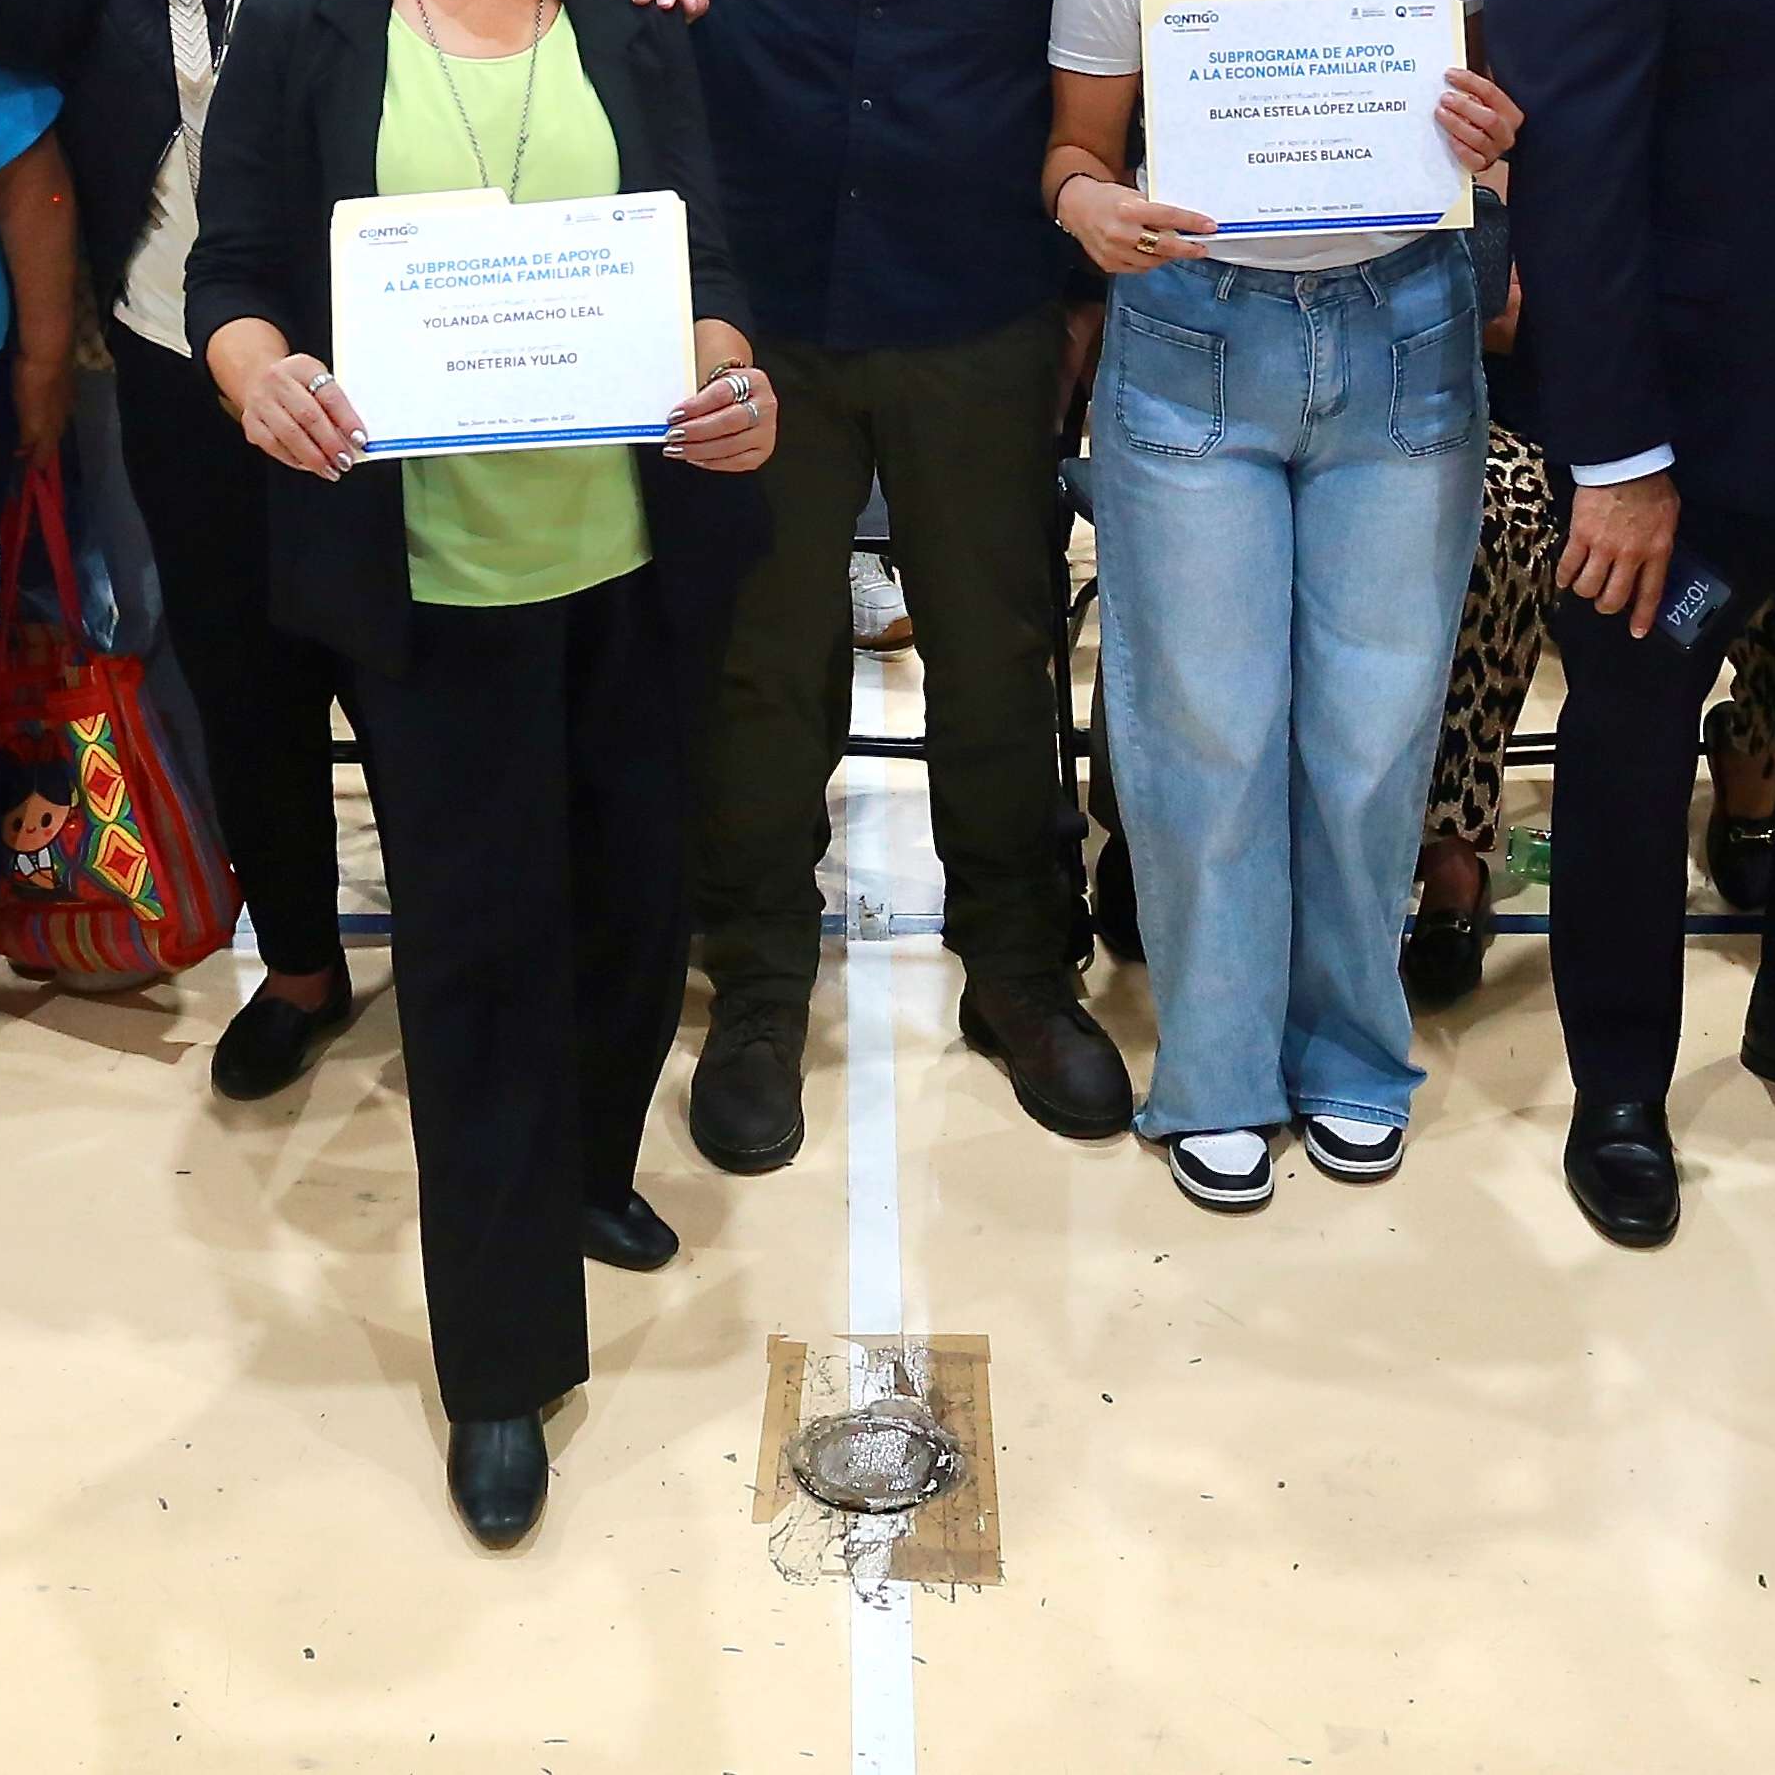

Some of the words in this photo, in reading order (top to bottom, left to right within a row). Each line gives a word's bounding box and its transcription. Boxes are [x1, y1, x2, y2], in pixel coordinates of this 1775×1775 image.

[1164, 10, 1219, 27] CONTIGO
[1208, 48, 1318, 64] SUBPROGRAMA
[1323, 47, 1342, 59] DE
[1345, 44, 1395, 58] APOYO
[1189, 69, 1200, 82] A
[1203, 68, 1222, 81] LA
[1225, 64, 1305, 79] ECONOMÍA
[1309, 61, 1376, 76] FAMILIAR
[1380, 59, 1416, 74] (PAE)
[1209, 106, 1260, 120] BLANCA
[1264, 104, 1311, 117] ESTELA
[1313, 101, 1354, 115] LÓPEZ
[1358, 101, 1407, 114] LIZARDI
[1248, 150, 1318, 164] EQUIPAJES
[1321, 148, 1373, 162] BLANCA
[359, 223, 418, 240] CONTIGO
[406, 256, 528, 275] SUBPROGRAMA
[533, 252, 553, 266] DE
[557, 248, 611, 263] APOYO
[384, 280, 396, 293] A
[400, 278, 420, 292] LA
[424, 271, 513, 289] ECONOMÍA
[517, 265, 591, 283] FAMILIAR
[595, 262, 634, 278] (PAE)
[423, 313, 489, 329] YOLANDA
[493, 307, 567, 325] CAMACHO
[571, 305, 604, 319] LEAL
[446, 356, 527, 372] BONETERIA
[530, 352, 577, 367] YULAO
[1666, 579, 1711, 626] 10:44
